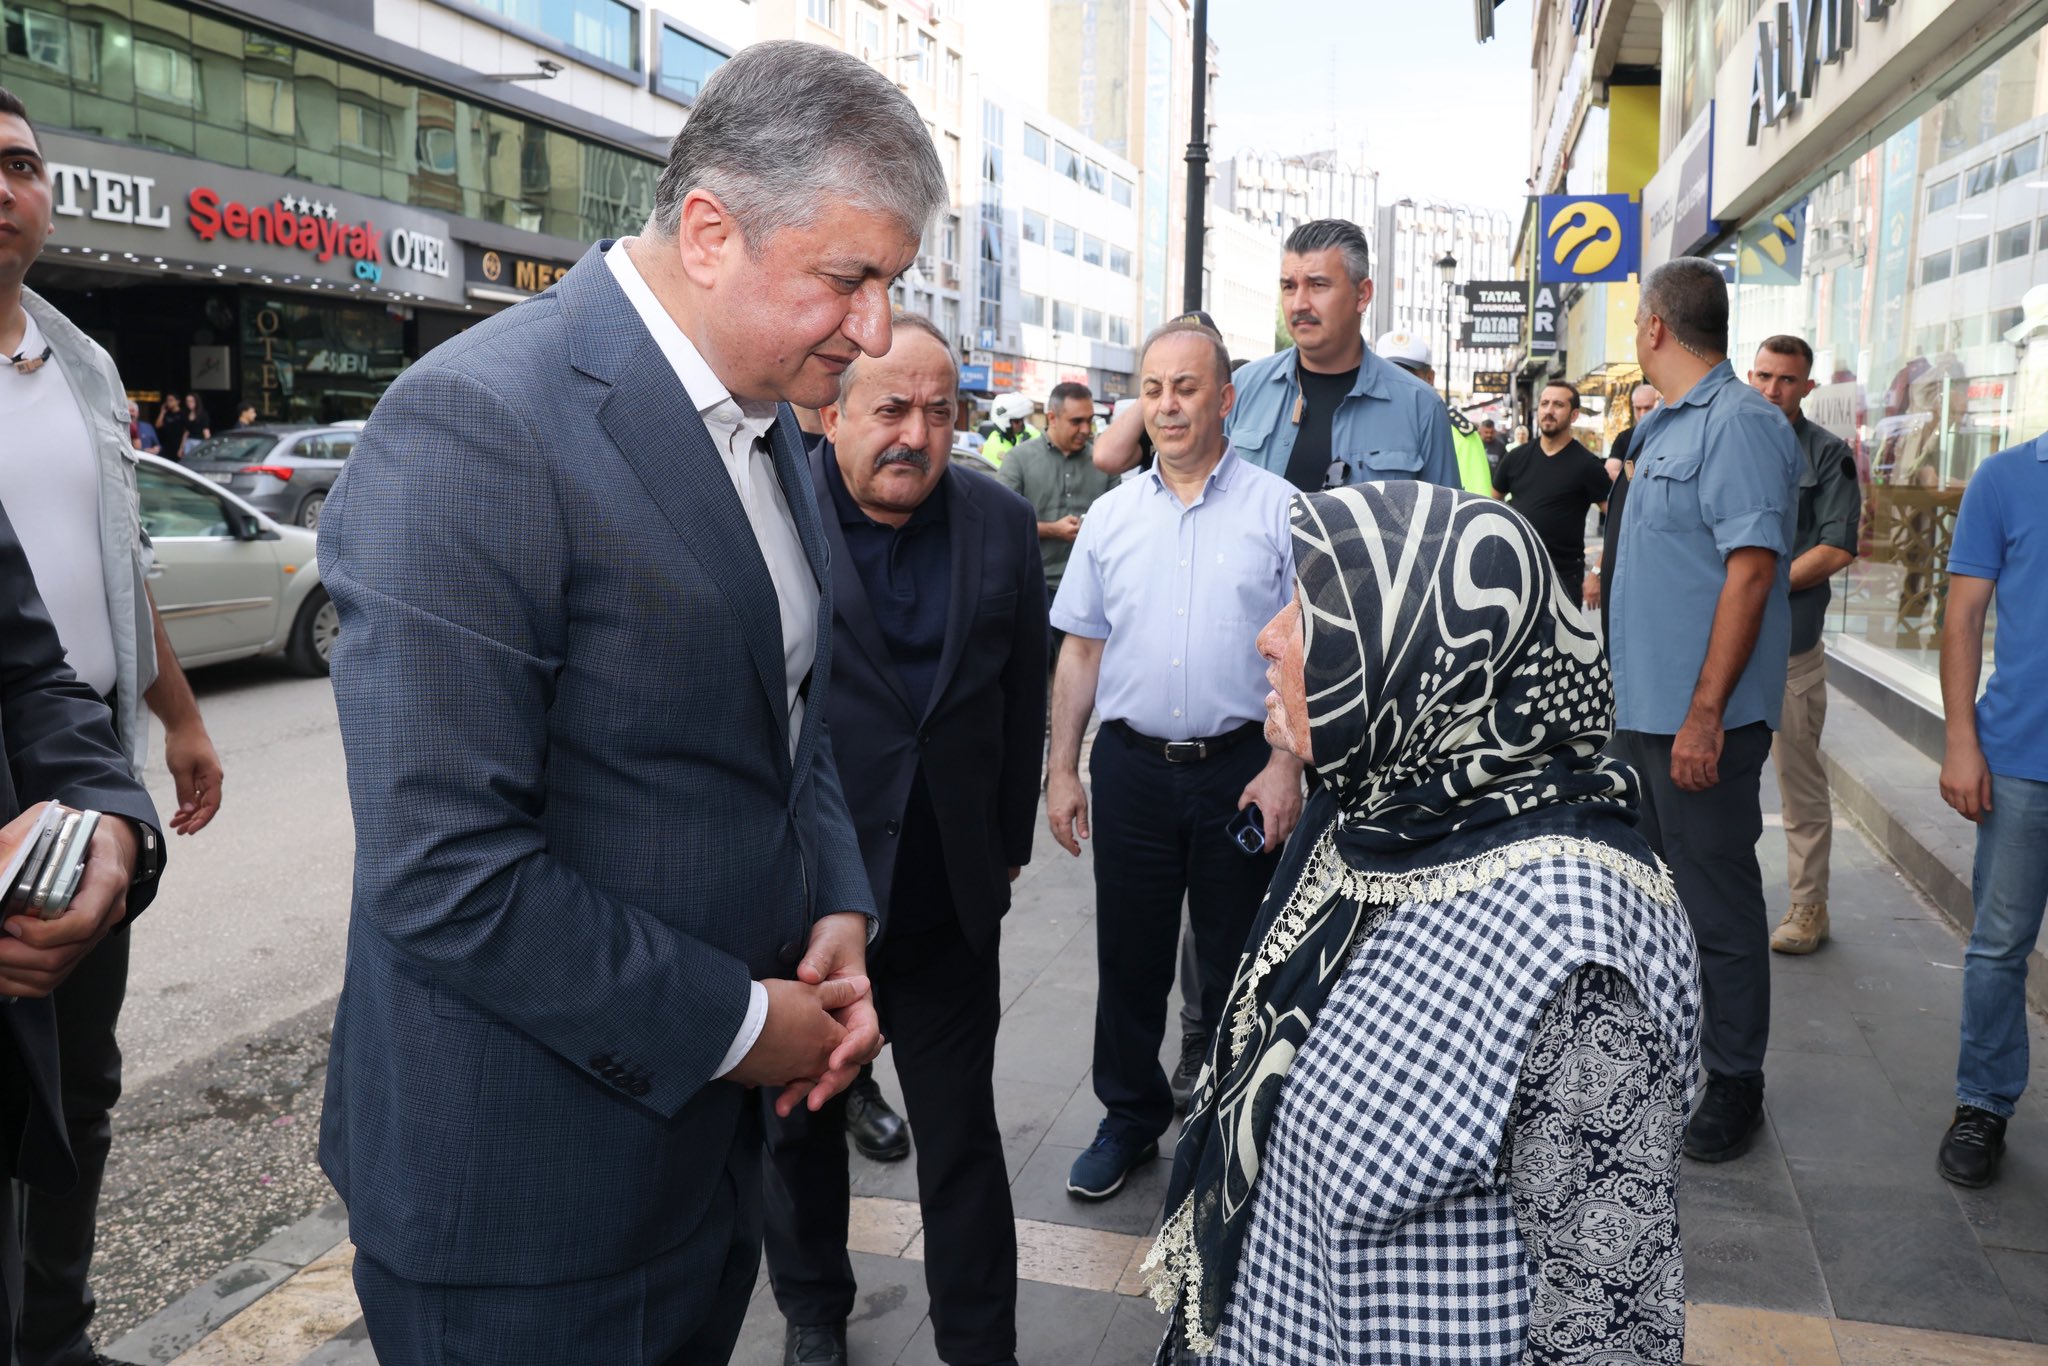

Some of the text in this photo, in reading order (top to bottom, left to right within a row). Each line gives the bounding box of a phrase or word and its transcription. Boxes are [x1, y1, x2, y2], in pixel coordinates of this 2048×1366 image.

[189, 187, 383, 263] Şenbayrak
[391, 228, 449, 278] OTEL
[355, 260, 383, 284] city
[1479, 291, 1521, 303] TATAR
[1474, 317, 1519, 333] TATAR
[257, 309, 279, 416] OTEL
[1815, 394, 1851, 425] ALVINA
